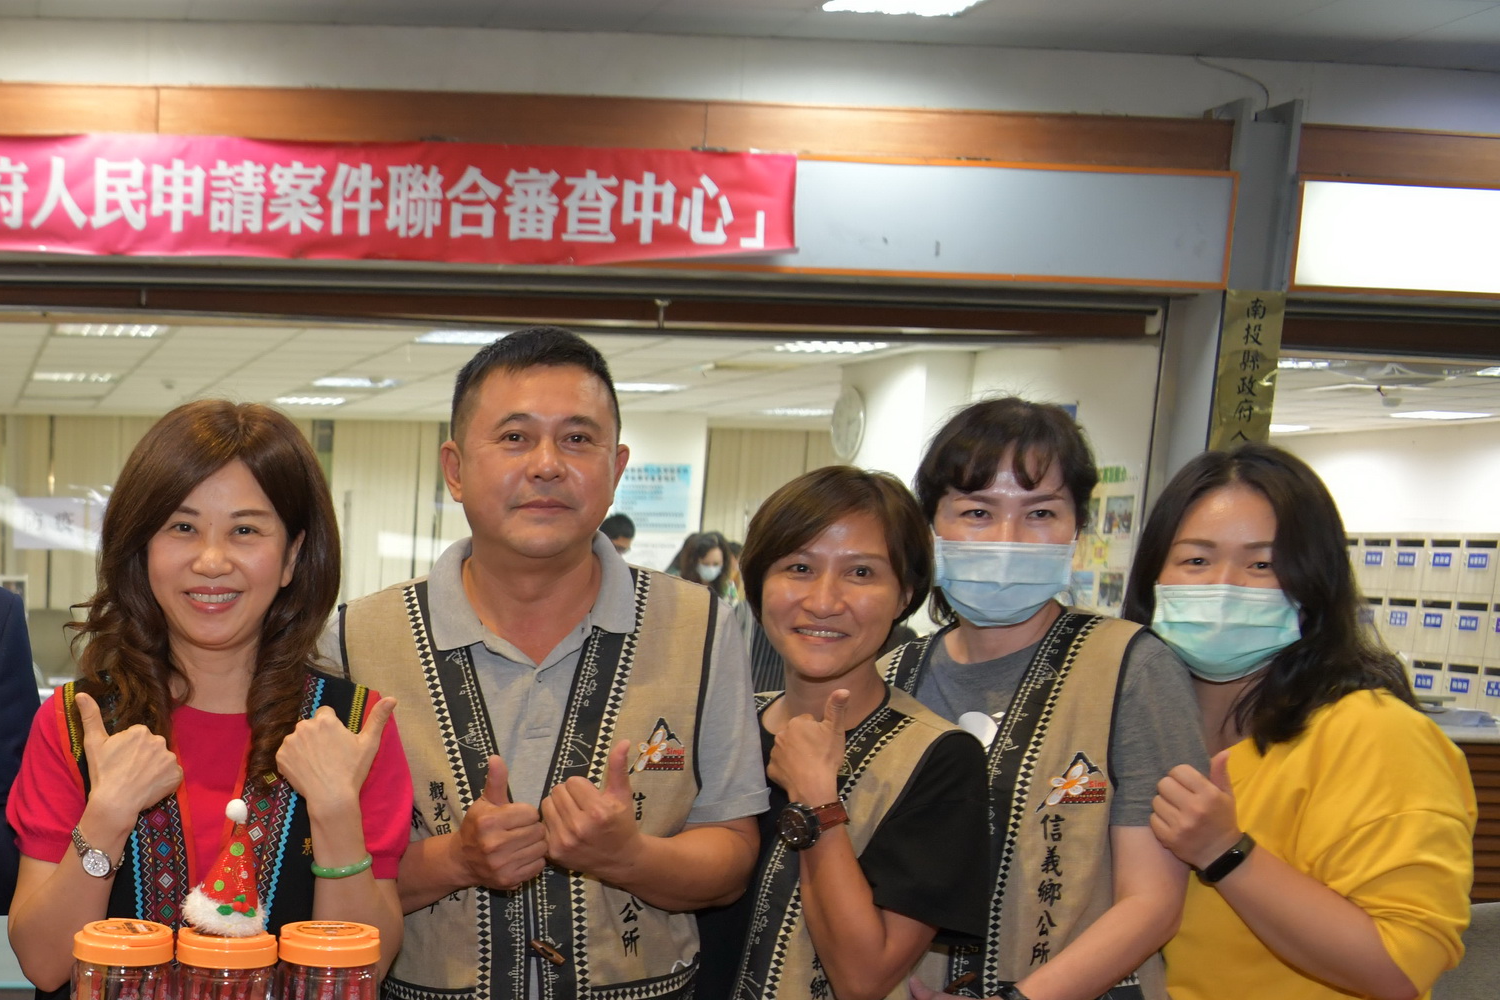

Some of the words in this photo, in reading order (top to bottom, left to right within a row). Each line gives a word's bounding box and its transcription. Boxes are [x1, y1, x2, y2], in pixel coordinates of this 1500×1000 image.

[1030, 814, 1065, 966] 信義鄉公所
